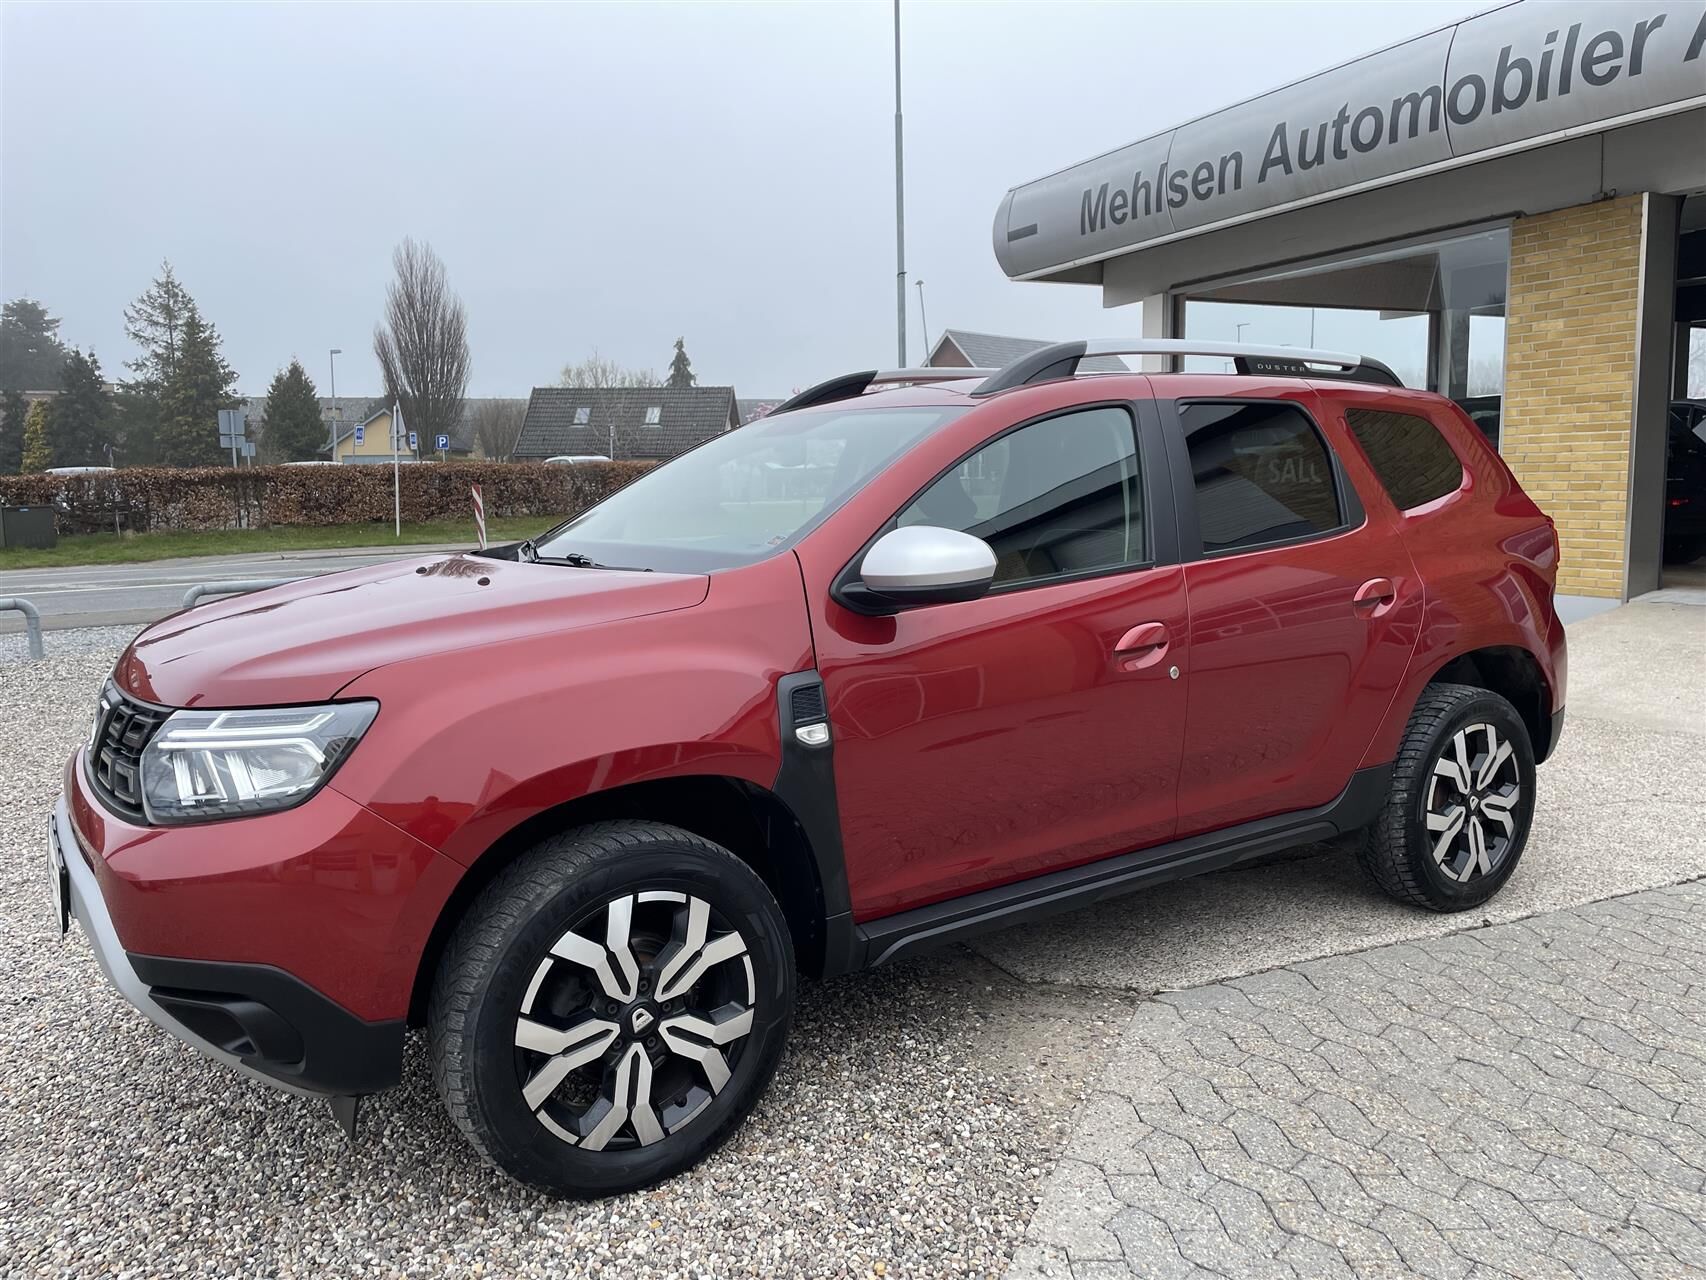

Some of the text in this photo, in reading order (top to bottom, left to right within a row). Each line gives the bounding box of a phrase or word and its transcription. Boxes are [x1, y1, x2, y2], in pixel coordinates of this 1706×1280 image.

[1081, 151, 1243, 236] Mehlsen
[1257, 14, 1668, 184] Automobiler
[1257, 362, 1305, 372] DUSTER
[439, 436, 447, 448] P
